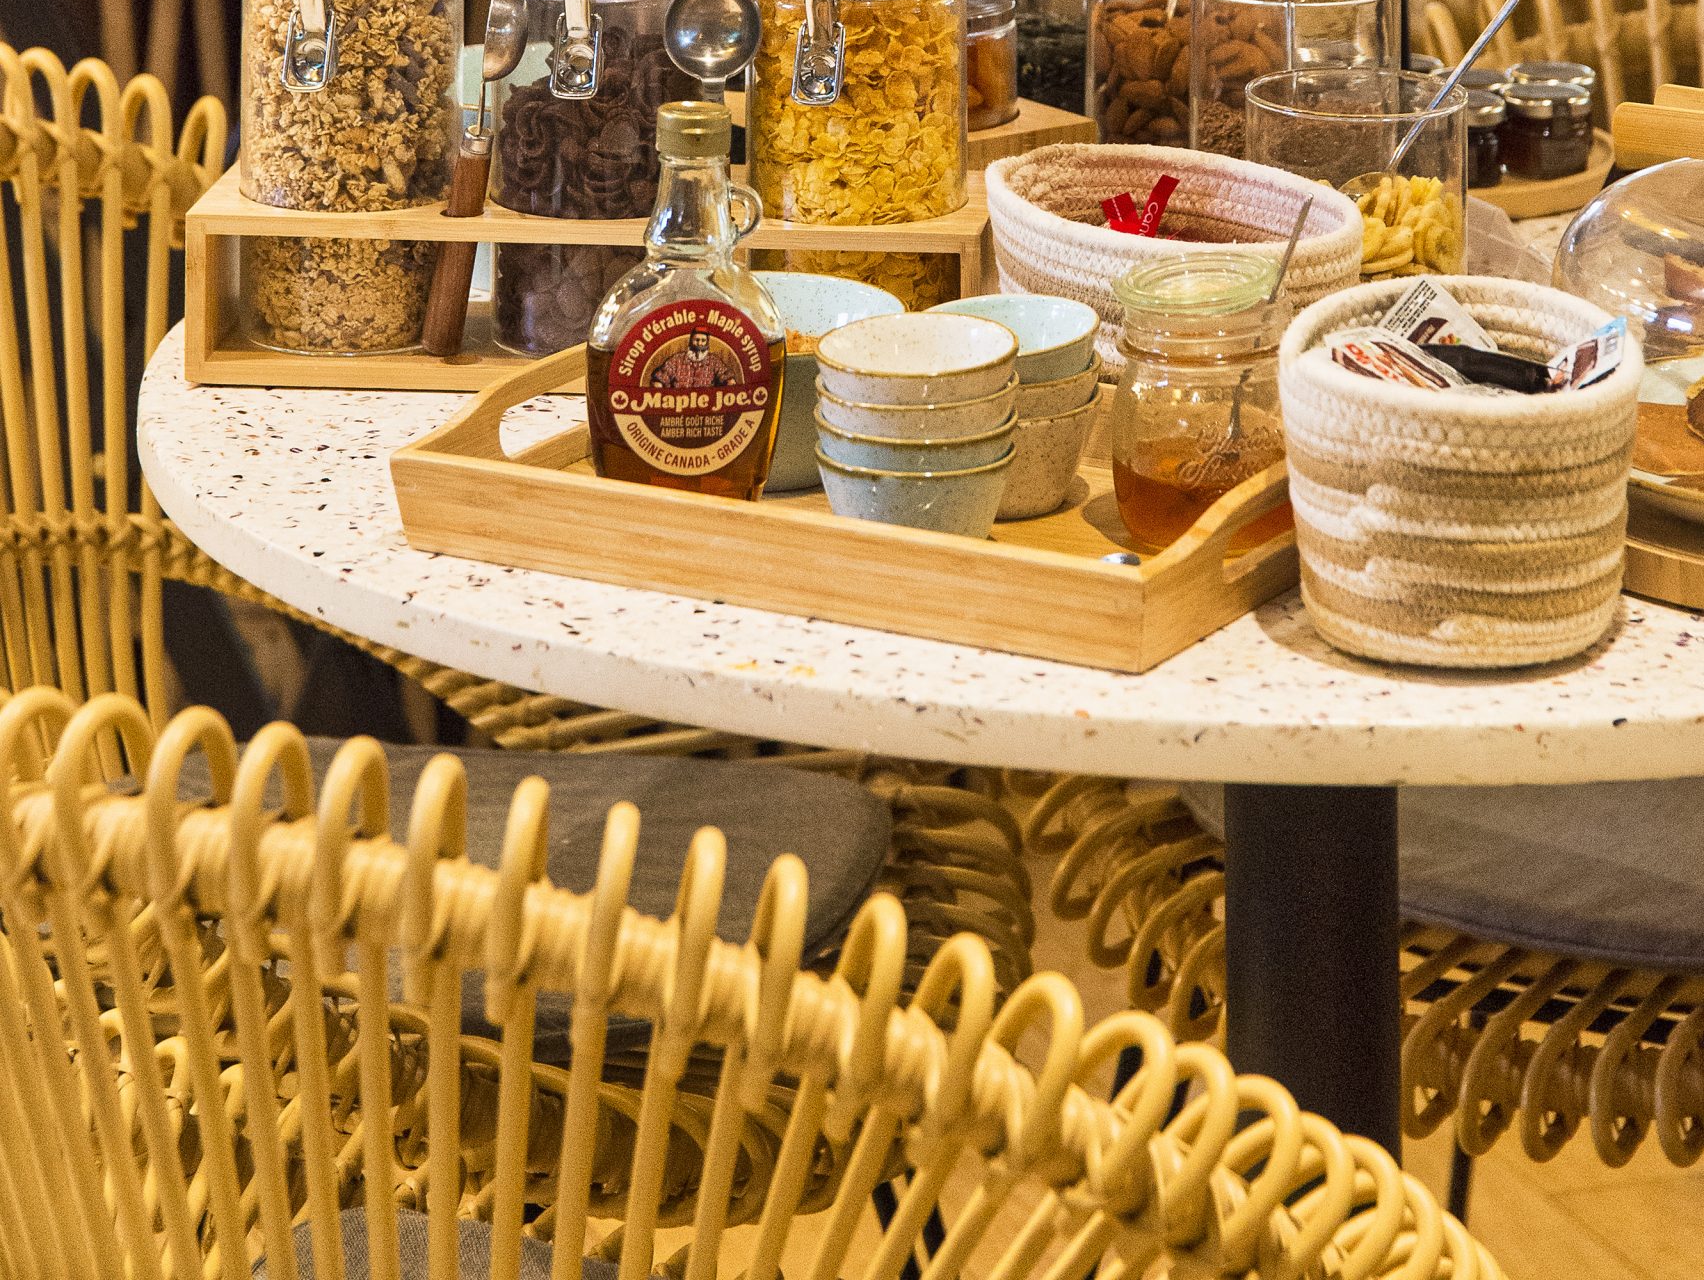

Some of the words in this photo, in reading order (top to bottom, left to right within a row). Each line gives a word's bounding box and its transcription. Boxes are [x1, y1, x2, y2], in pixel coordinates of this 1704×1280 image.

[619, 339, 645, 376] Sirop
[642, 309, 695, 341] d'érable
[707, 309, 744, 338] Maple
[741, 333, 762, 372] syrup
[630, 390, 708, 412] Maple
[712, 391, 751, 412] Joe
[660, 415, 684, 426] AMBRÉ
[686, 415, 703, 426] GOÛT
[705, 415, 724, 426] RICHE
[661, 427, 685, 437] AMBER
[686, 427, 702, 437] RICH
[703, 427, 723, 436] TASTE
[627, 421, 662, 460] ORIGINE
[664, 453, 710, 469] CANADA
[717, 430, 749, 460] GRADE
[746, 418, 755, 428] A
